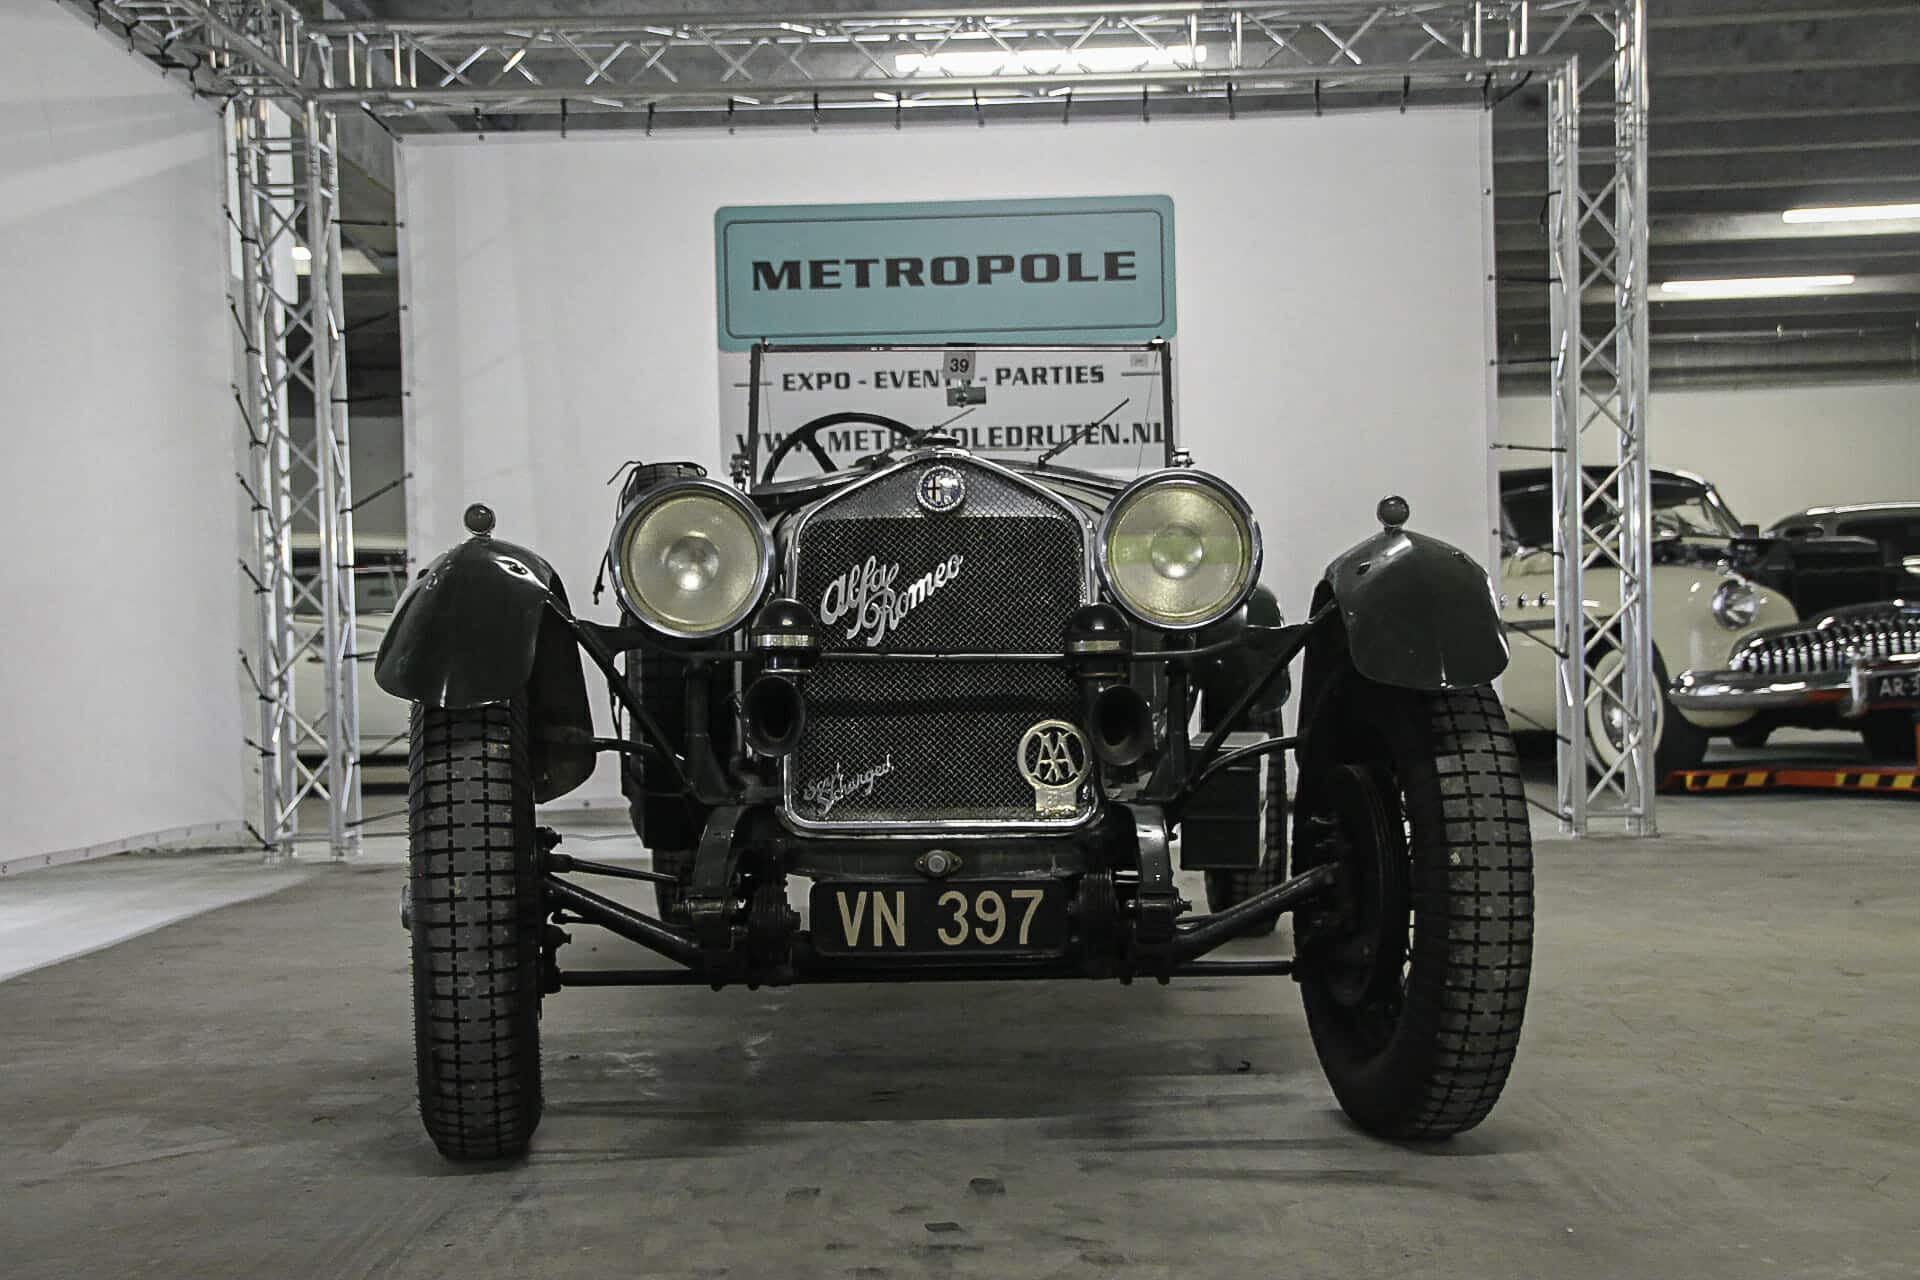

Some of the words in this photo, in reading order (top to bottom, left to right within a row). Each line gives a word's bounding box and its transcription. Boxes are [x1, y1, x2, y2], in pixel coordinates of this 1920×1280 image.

[751, 250, 1137, 291] METROPOLE
[782, 371, 851, 392] EXPO
[874, 368, 973, 389] EVEN
[995, 364, 1105, 386] PARTIES
[950, 358, 970, 373] 39
[820, 555, 899, 640] Alfa
[863, 554, 964, 647] Romeo
[836, 891, 905, 947] VN
[938, 889, 1044, 945] 397
